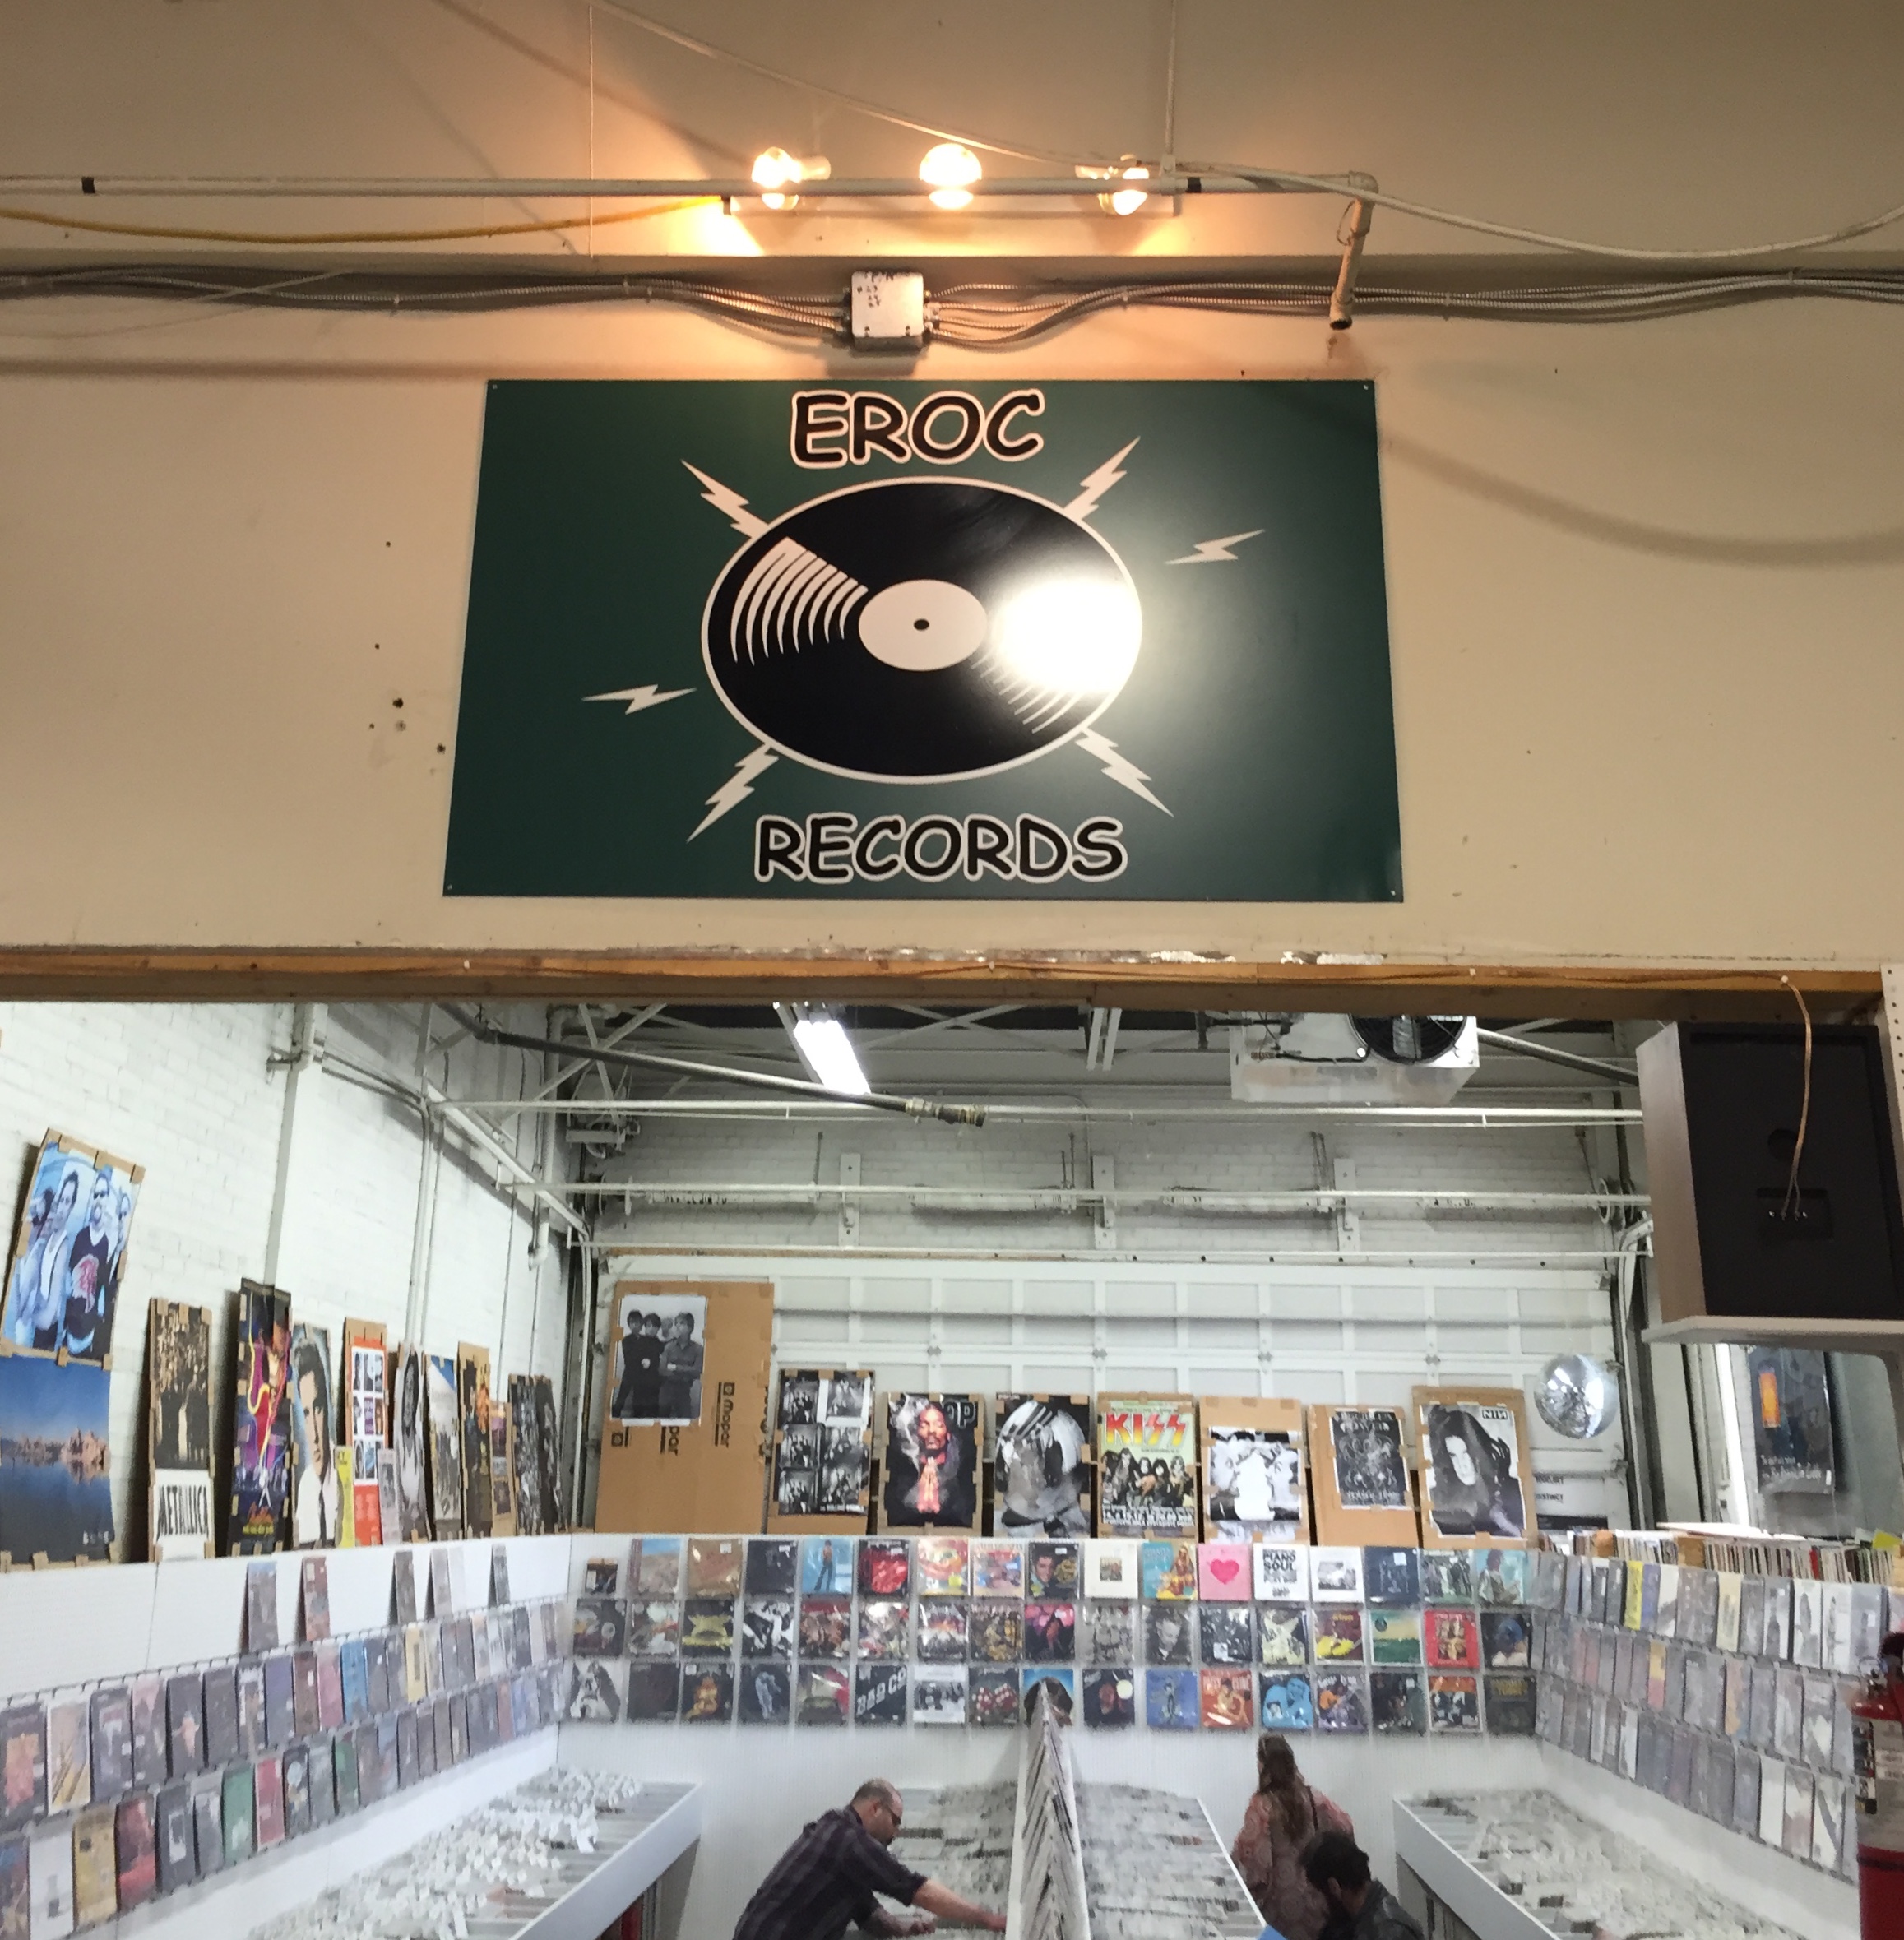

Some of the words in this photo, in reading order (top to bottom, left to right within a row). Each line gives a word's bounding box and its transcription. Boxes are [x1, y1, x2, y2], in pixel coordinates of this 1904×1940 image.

[790, 388, 1045, 469] EROC
[754, 812, 1128, 884] RECORDS
[1105, 1412, 1187, 1447] KISS
[156, 1484, 209, 1541] METALLICA
